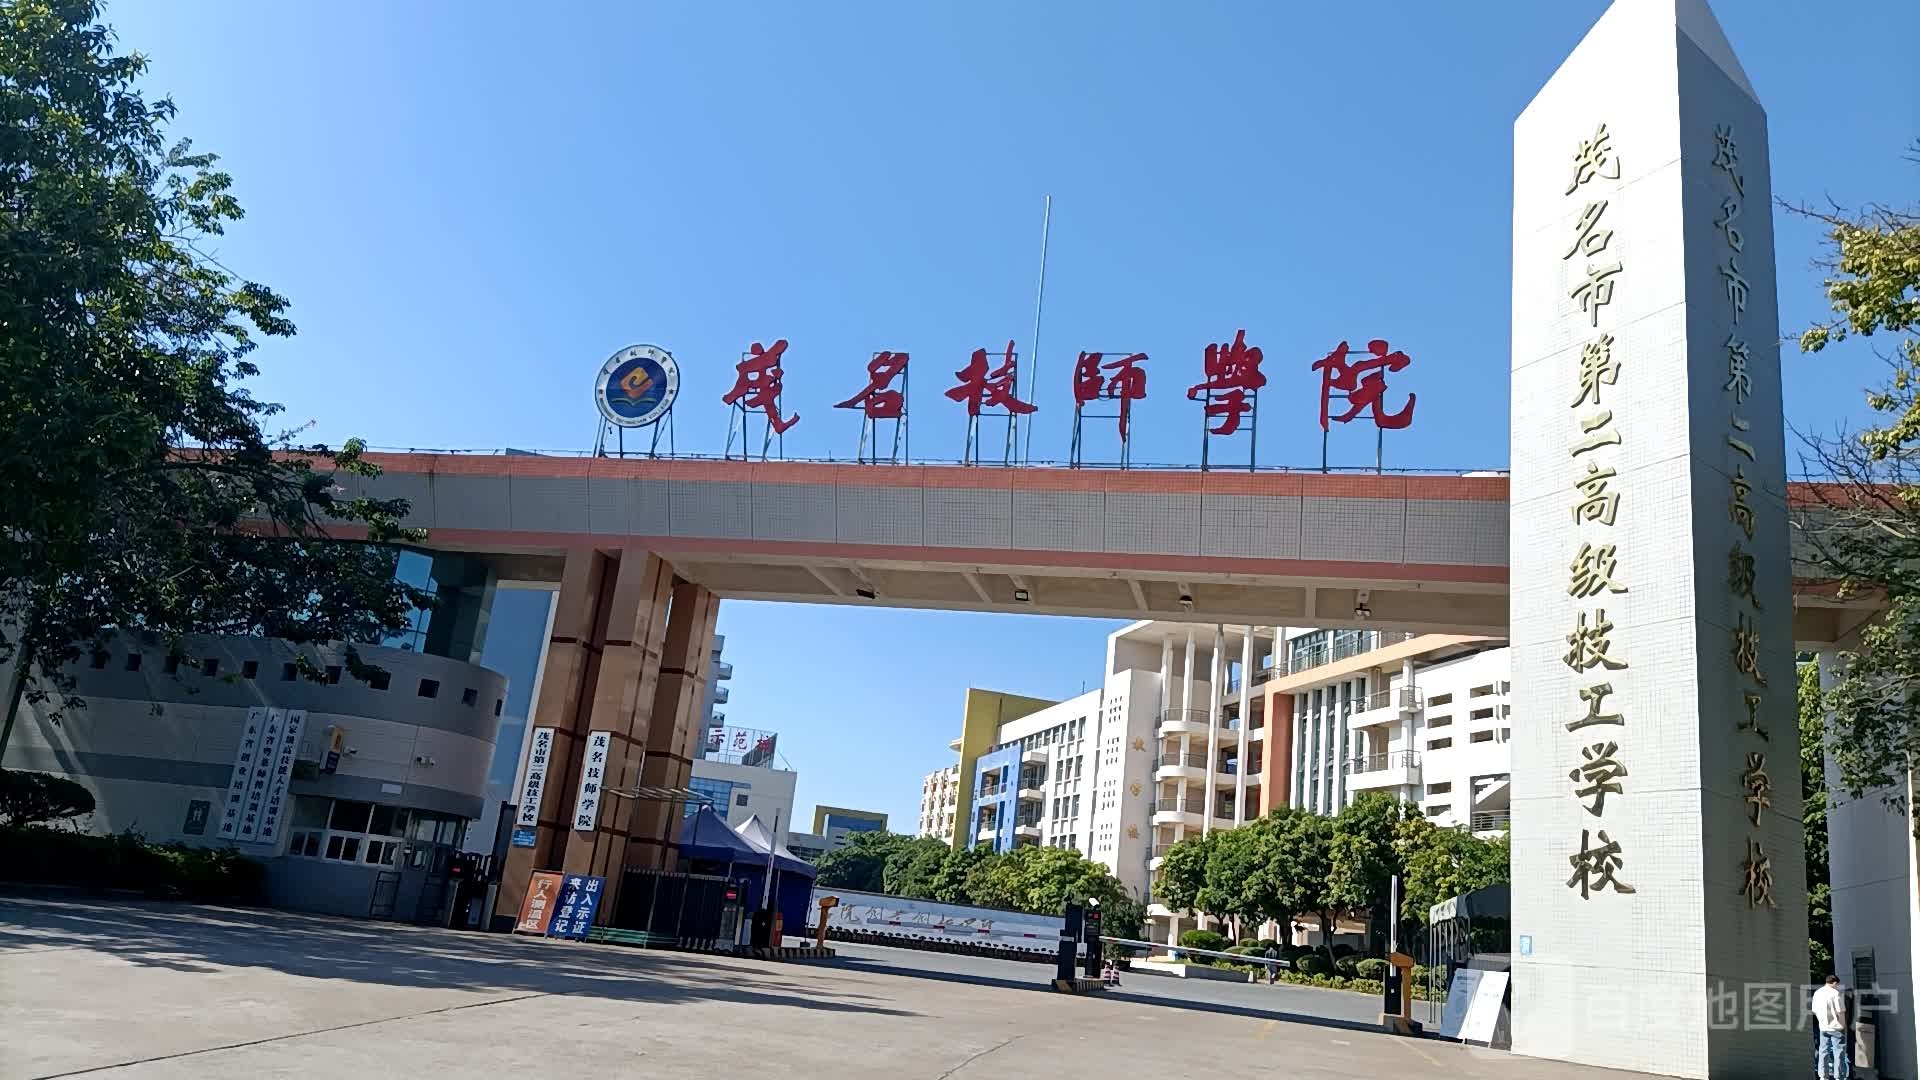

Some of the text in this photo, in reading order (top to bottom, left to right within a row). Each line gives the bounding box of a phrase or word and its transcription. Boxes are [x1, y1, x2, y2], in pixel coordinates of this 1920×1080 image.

[1563, 122, 1637, 901] 茂名市第二高级技工学校
[1711, 122, 1776, 909] 茂名市第二高级技工学校
[522, 731, 550, 822] 茂名市第二高级技工学校
[697, 728, 774, 752] 示范校
[577, 735, 607, 827] 茂名技师学院
[525, 879, 553, 930] 行人测温区
[554, 877, 582, 933] 来访登记
[572, 879, 599, 934] 出入示证
